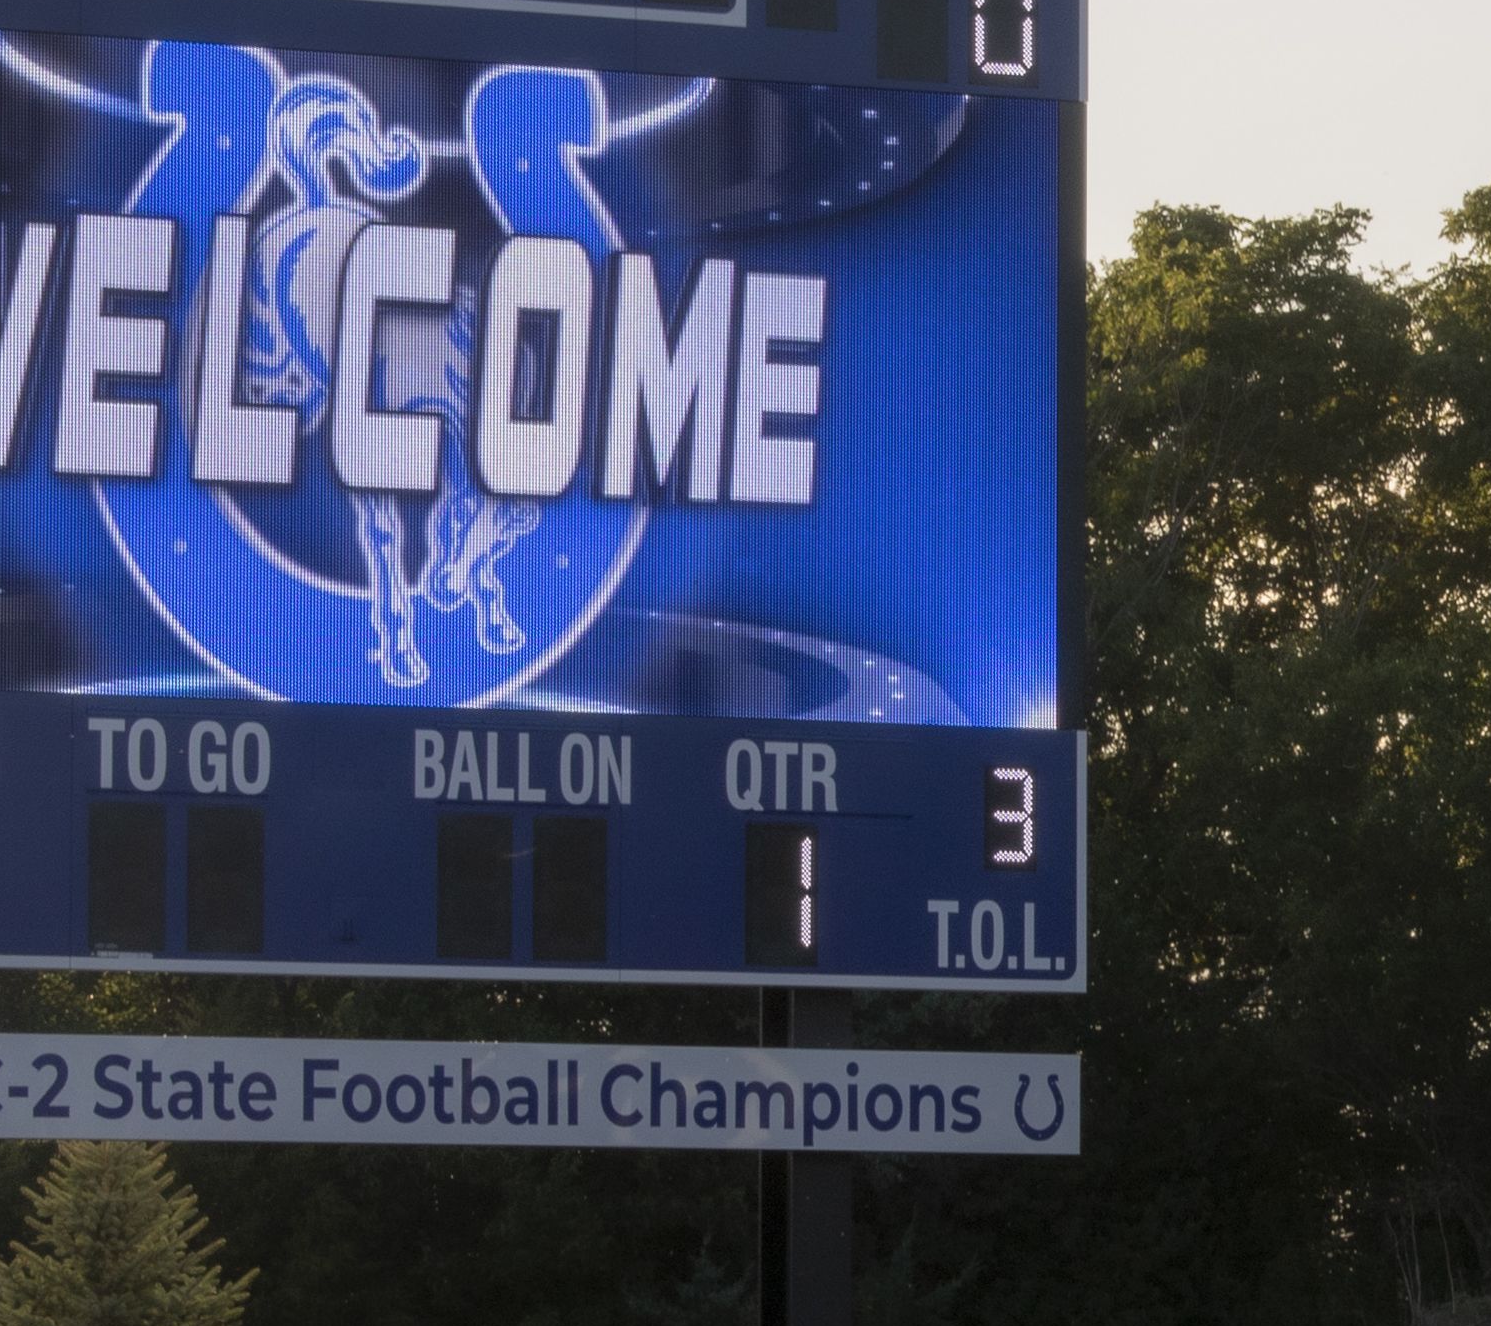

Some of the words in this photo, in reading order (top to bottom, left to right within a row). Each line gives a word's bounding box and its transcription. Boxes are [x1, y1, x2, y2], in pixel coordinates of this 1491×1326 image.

[87, 717, 168, 792] TO
[187, 721, 272, 795] GO
[413, 728, 547, 803] BALL
[559, 732, 632, 806] ON
[725, 739, 839, 813] QTR
[992, 767, 1035, 864] 3
[800, 837, 813, 948] 1
[926, 900, 1067, 972] T.O.L.
[92, 1054, 278, 1122] State
[302, 1057, 580, 1127] Football
[599, 1061, 983, 1148] Champions
